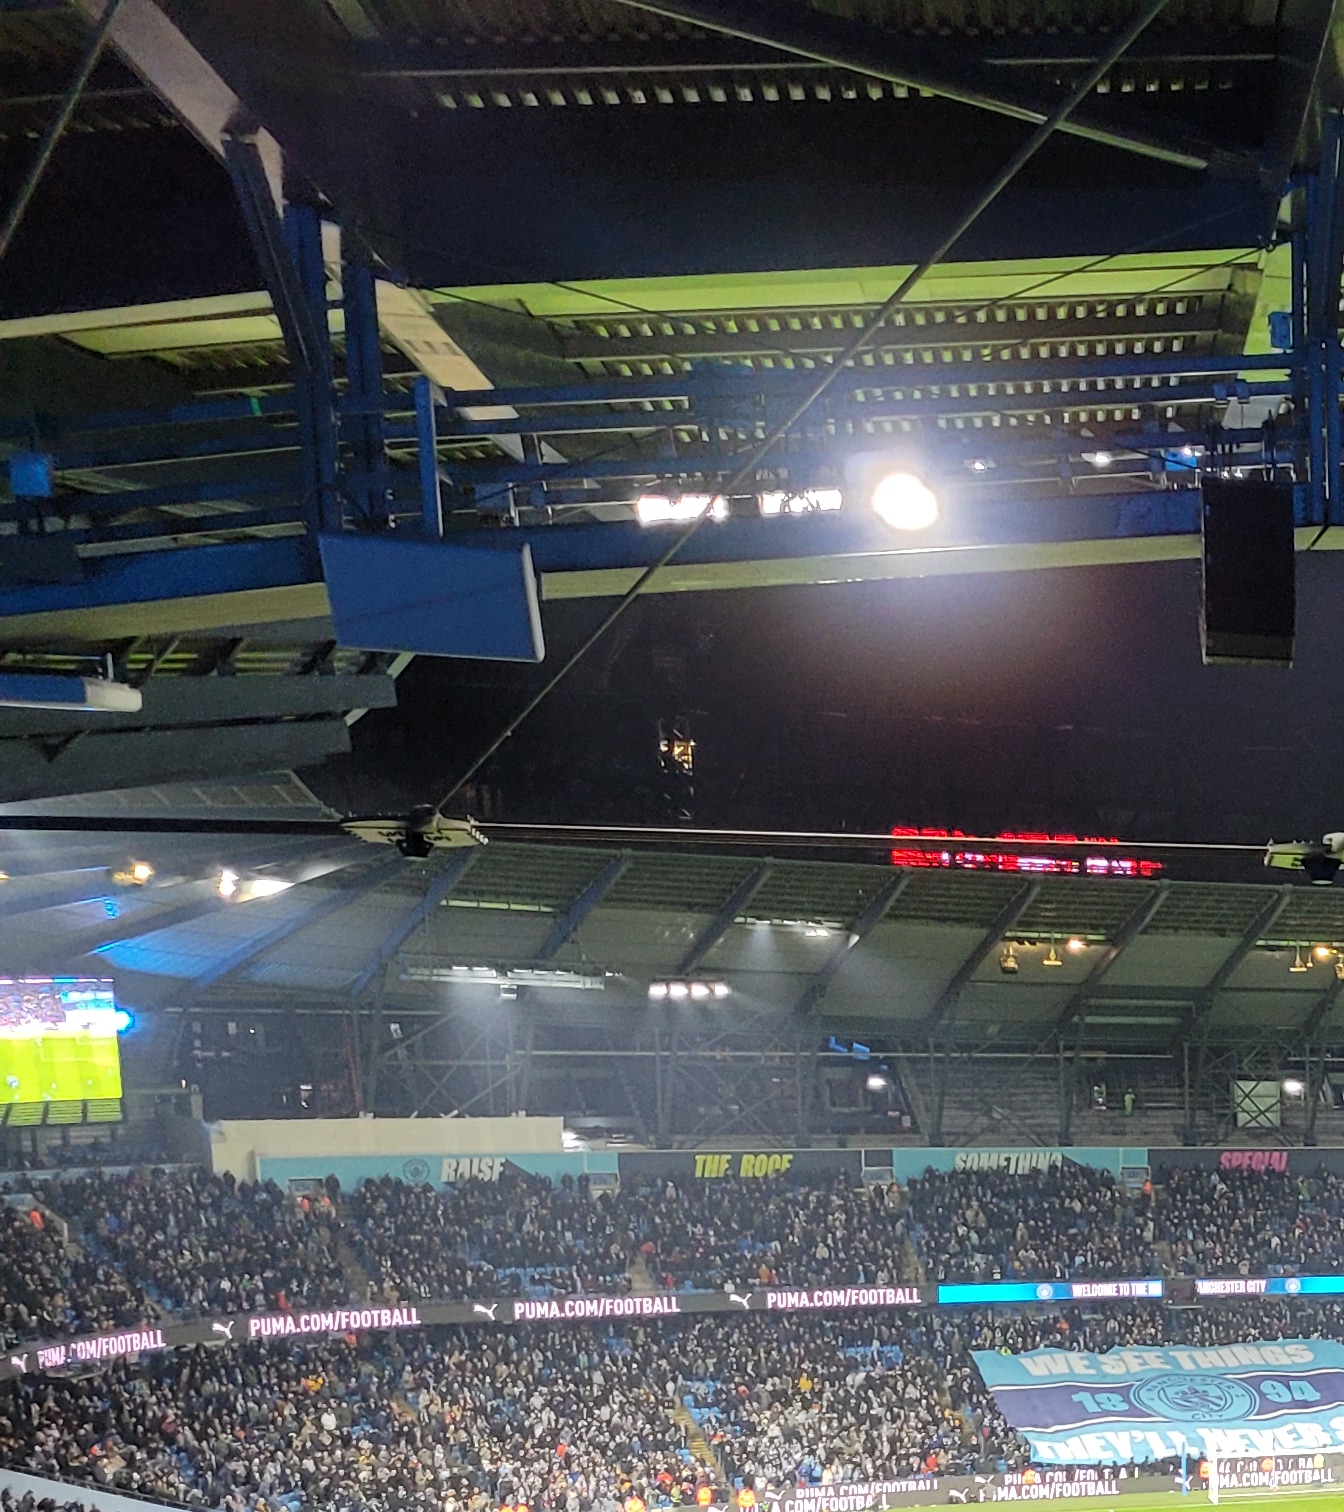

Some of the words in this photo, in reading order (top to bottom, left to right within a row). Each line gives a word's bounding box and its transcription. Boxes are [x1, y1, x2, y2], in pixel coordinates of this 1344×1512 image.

[695, 1154, 732, 1178] THE
[766, 1286, 922, 1309] PUMA.COM/FOOTBALL
[1071, 1282, 1119, 1297] WELCOME
[513, 1296, 681, 1320] PUMA.COM/FOOTBALL
[249, 1307, 422, 1337] PUMA.COM/FOOTBALL
[1019, 1355, 1097, 1377] WE
[1100, 1349, 1173, 1374] SEE
[1174, 1342, 1316, 1372] THINGS
[1071, 1391, 1130, 1414] 18
[1259, 1379, 1323, 1403] 94
[1199, 1420, 1332, 1457] NEVER
